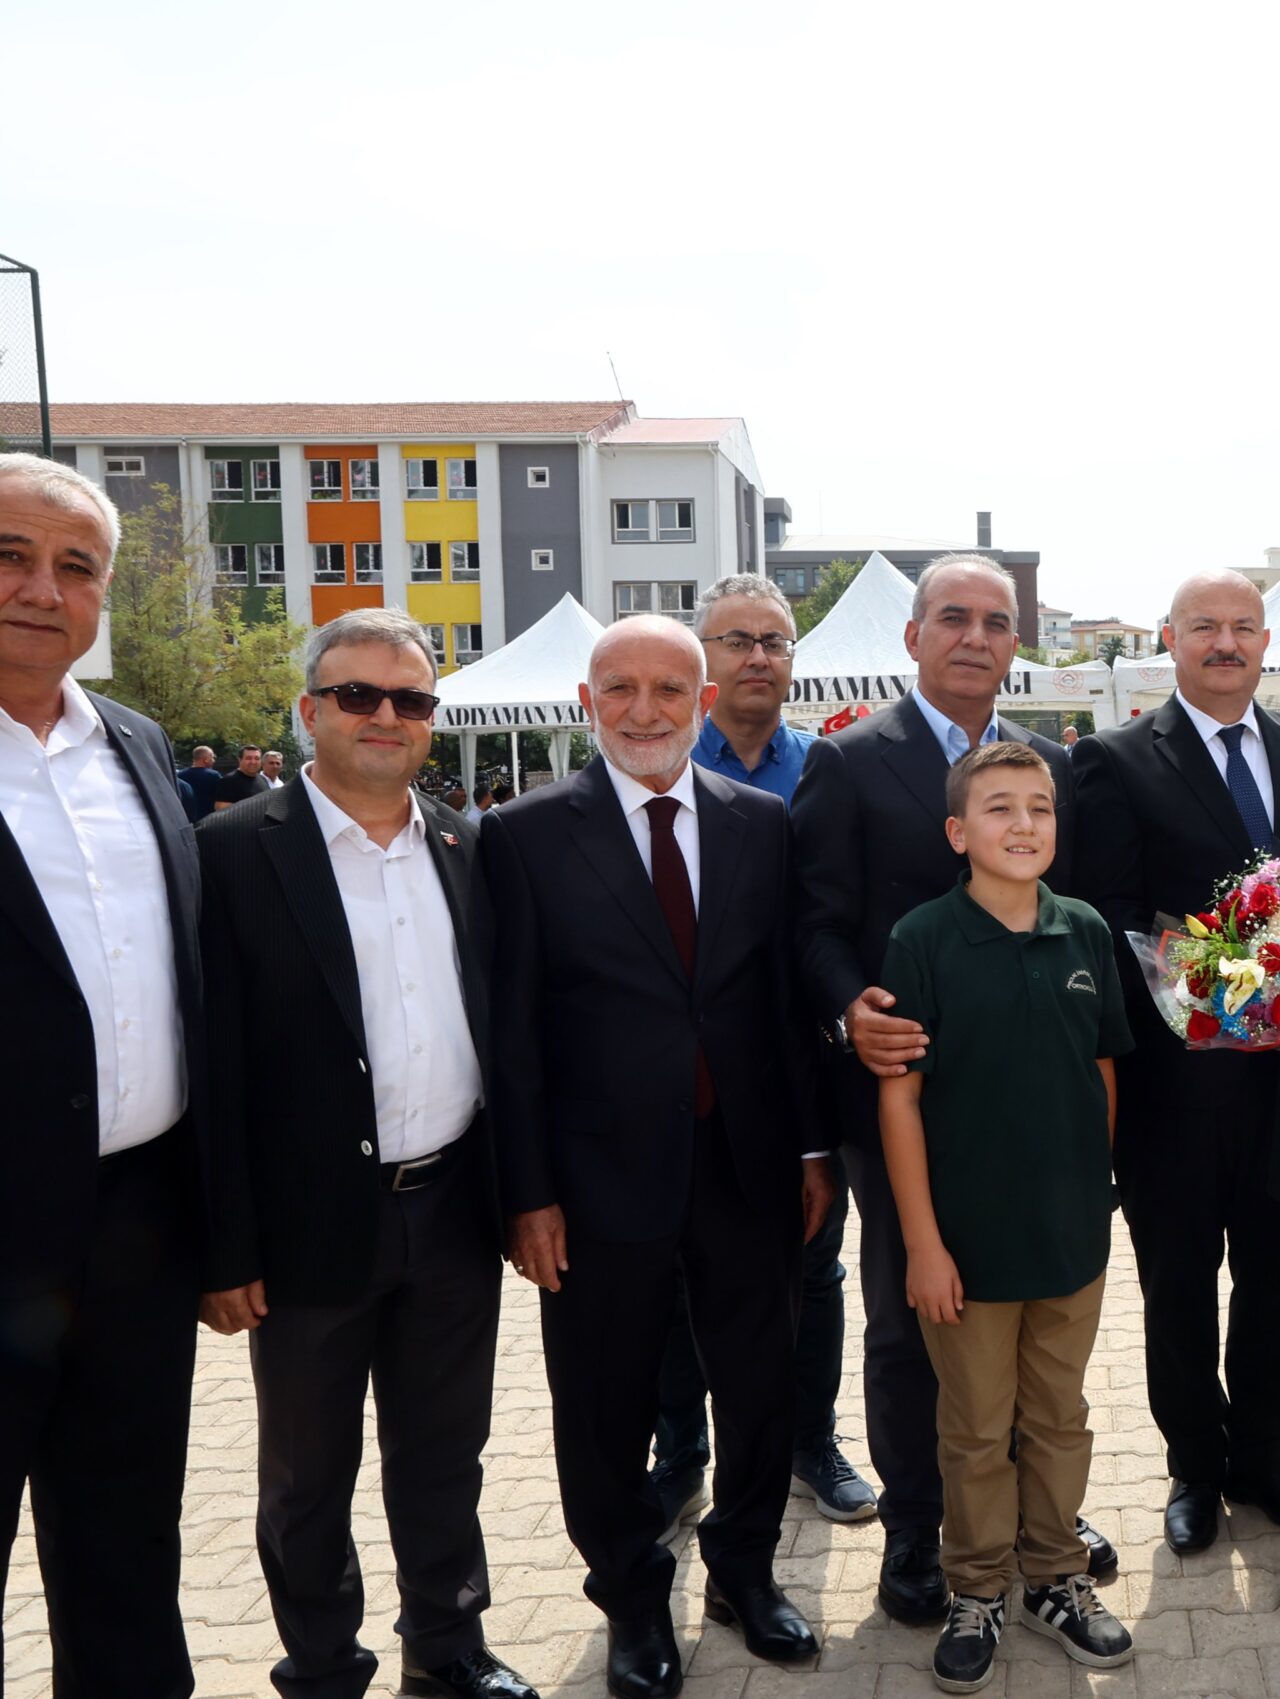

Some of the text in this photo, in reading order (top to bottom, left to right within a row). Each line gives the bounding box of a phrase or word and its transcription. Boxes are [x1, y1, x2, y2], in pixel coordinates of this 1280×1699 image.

[786, 676, 907, 703] DIYAMAN
[441, 704, 591, 726] ADIYAMAN VAL
